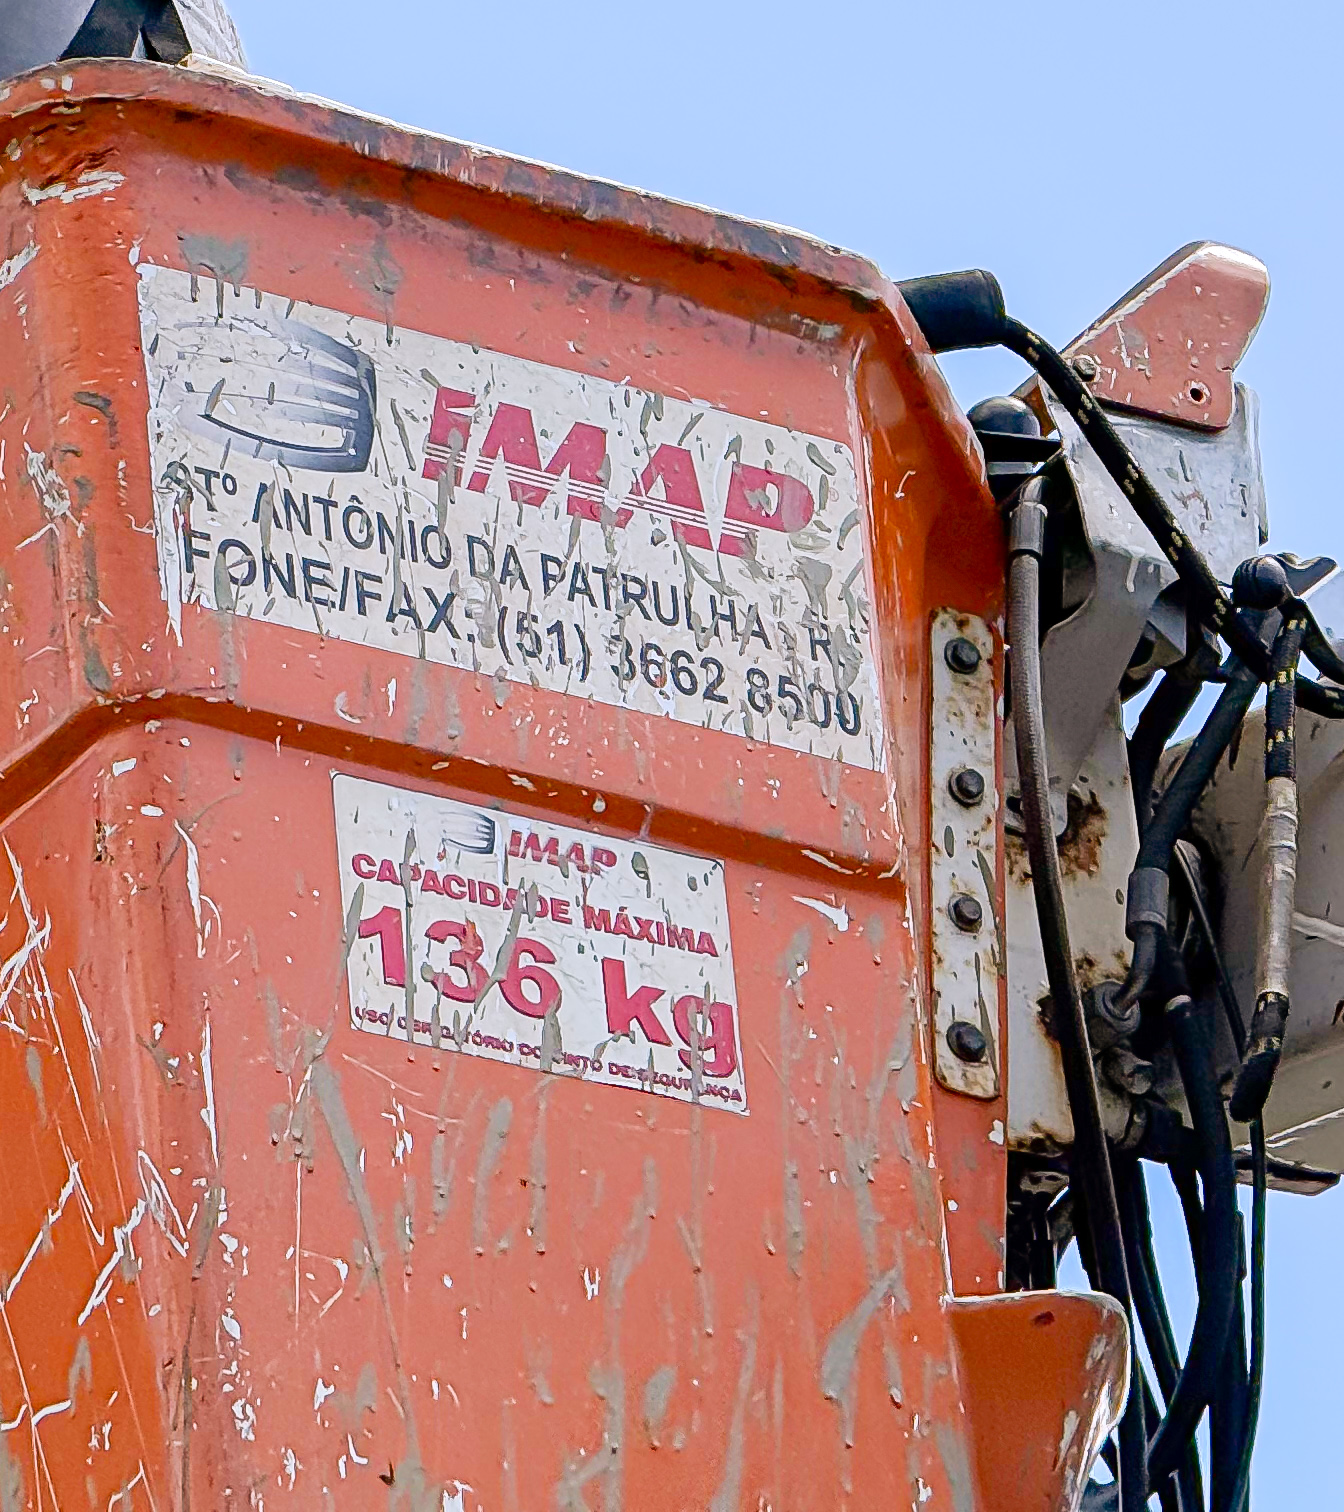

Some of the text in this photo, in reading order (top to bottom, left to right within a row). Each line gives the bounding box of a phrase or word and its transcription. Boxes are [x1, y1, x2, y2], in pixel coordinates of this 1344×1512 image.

[422, 387, 815, 557] IMAP
[184, 529, 862, 736] FONE/FAX: (51) 3662 8500
[252, 482, 452, 570] ANTÔNIO
[467, 534, 531, 592] DA
[540, 552, 773, 652] PATRULHA
[351, 853, 720, 958] CAPACIDADE MÁXIMA
[508, 829, 618, 876] IMAP
[357, 904, 738, 1078] 136 kg
[397, 1016, 515, 1054] OBRGÓRIO
[635, 1066, 743, 1104] EGURNÇA
